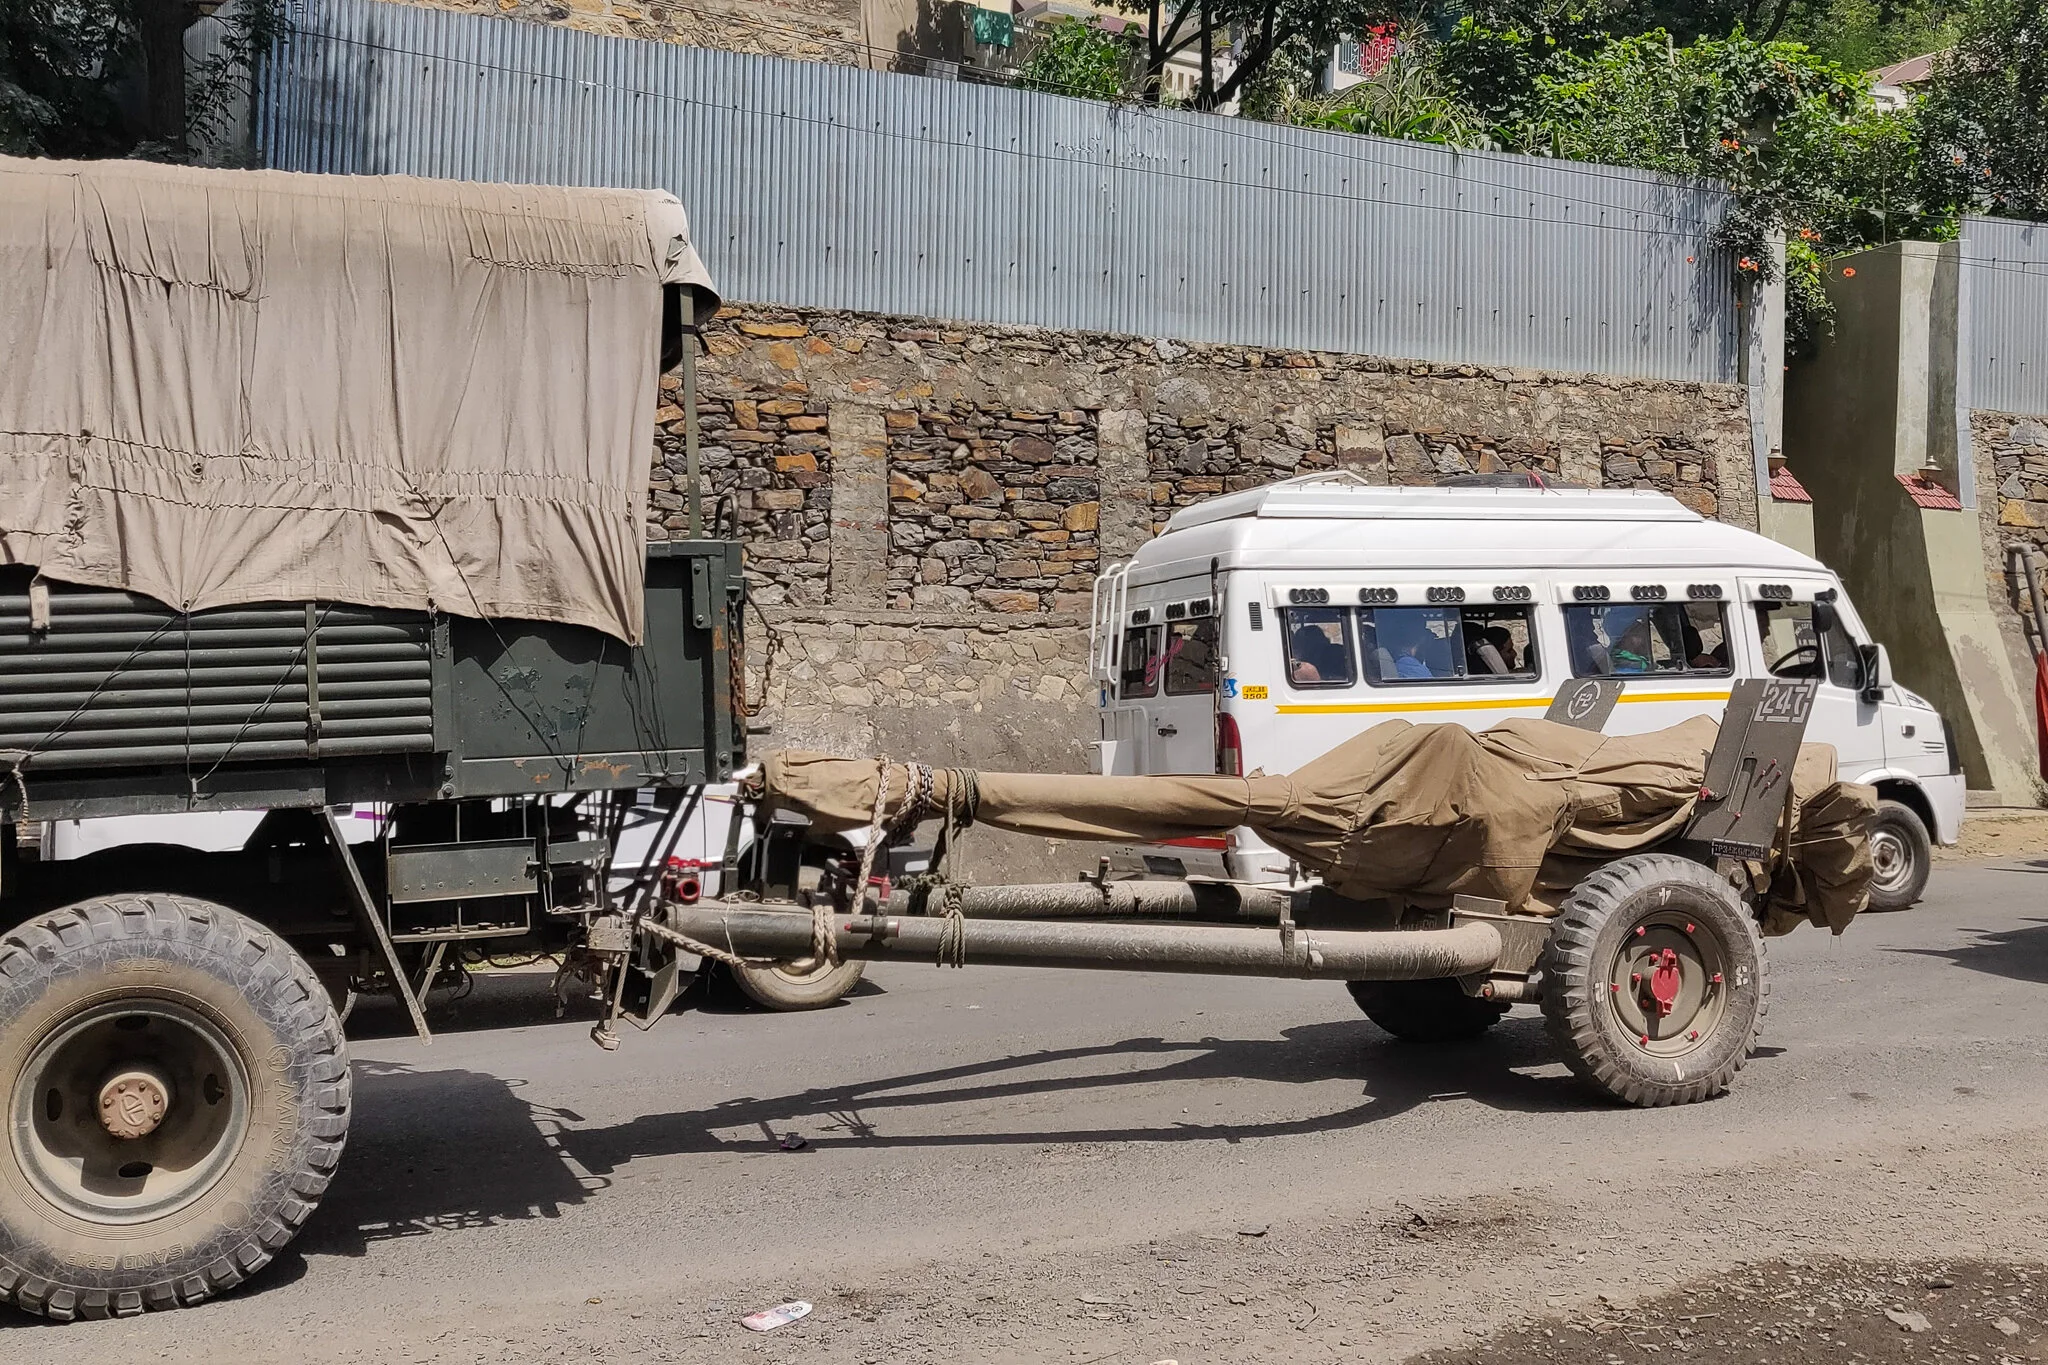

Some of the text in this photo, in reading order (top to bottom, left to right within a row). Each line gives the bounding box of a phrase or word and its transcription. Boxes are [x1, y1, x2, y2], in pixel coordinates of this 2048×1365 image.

[1575, 693, 1593, 708] F2
[1762, 686, 1806, 715] 247
[65, 1243, 184, 1271] SAND GRIP
